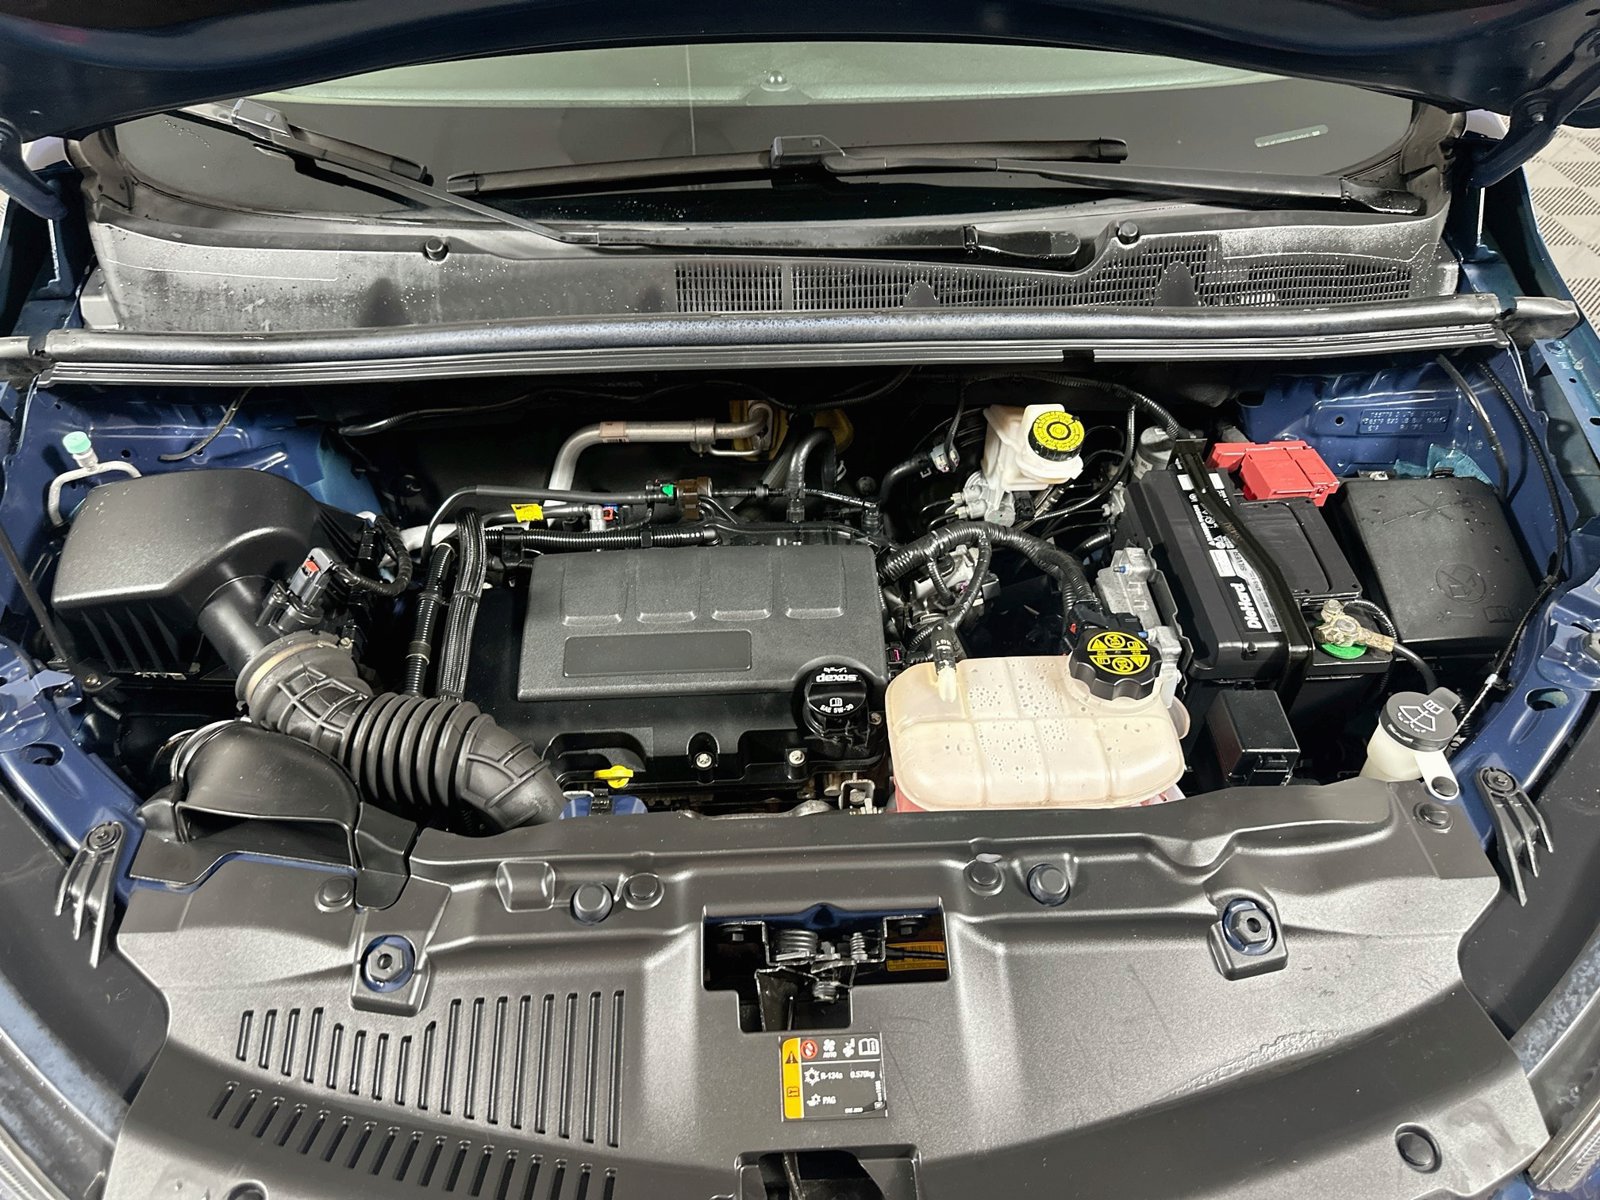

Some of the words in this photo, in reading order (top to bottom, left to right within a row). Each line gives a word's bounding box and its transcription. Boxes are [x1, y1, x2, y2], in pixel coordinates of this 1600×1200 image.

[1230, 582, 1263, 629] DieHard
[816, 673, 858, 682] dexos
[833, 703, 854, 713] 5W-30
[820, 1071, 843, 1080] R-134a
[822, 1096, 837, 1104] PAG
